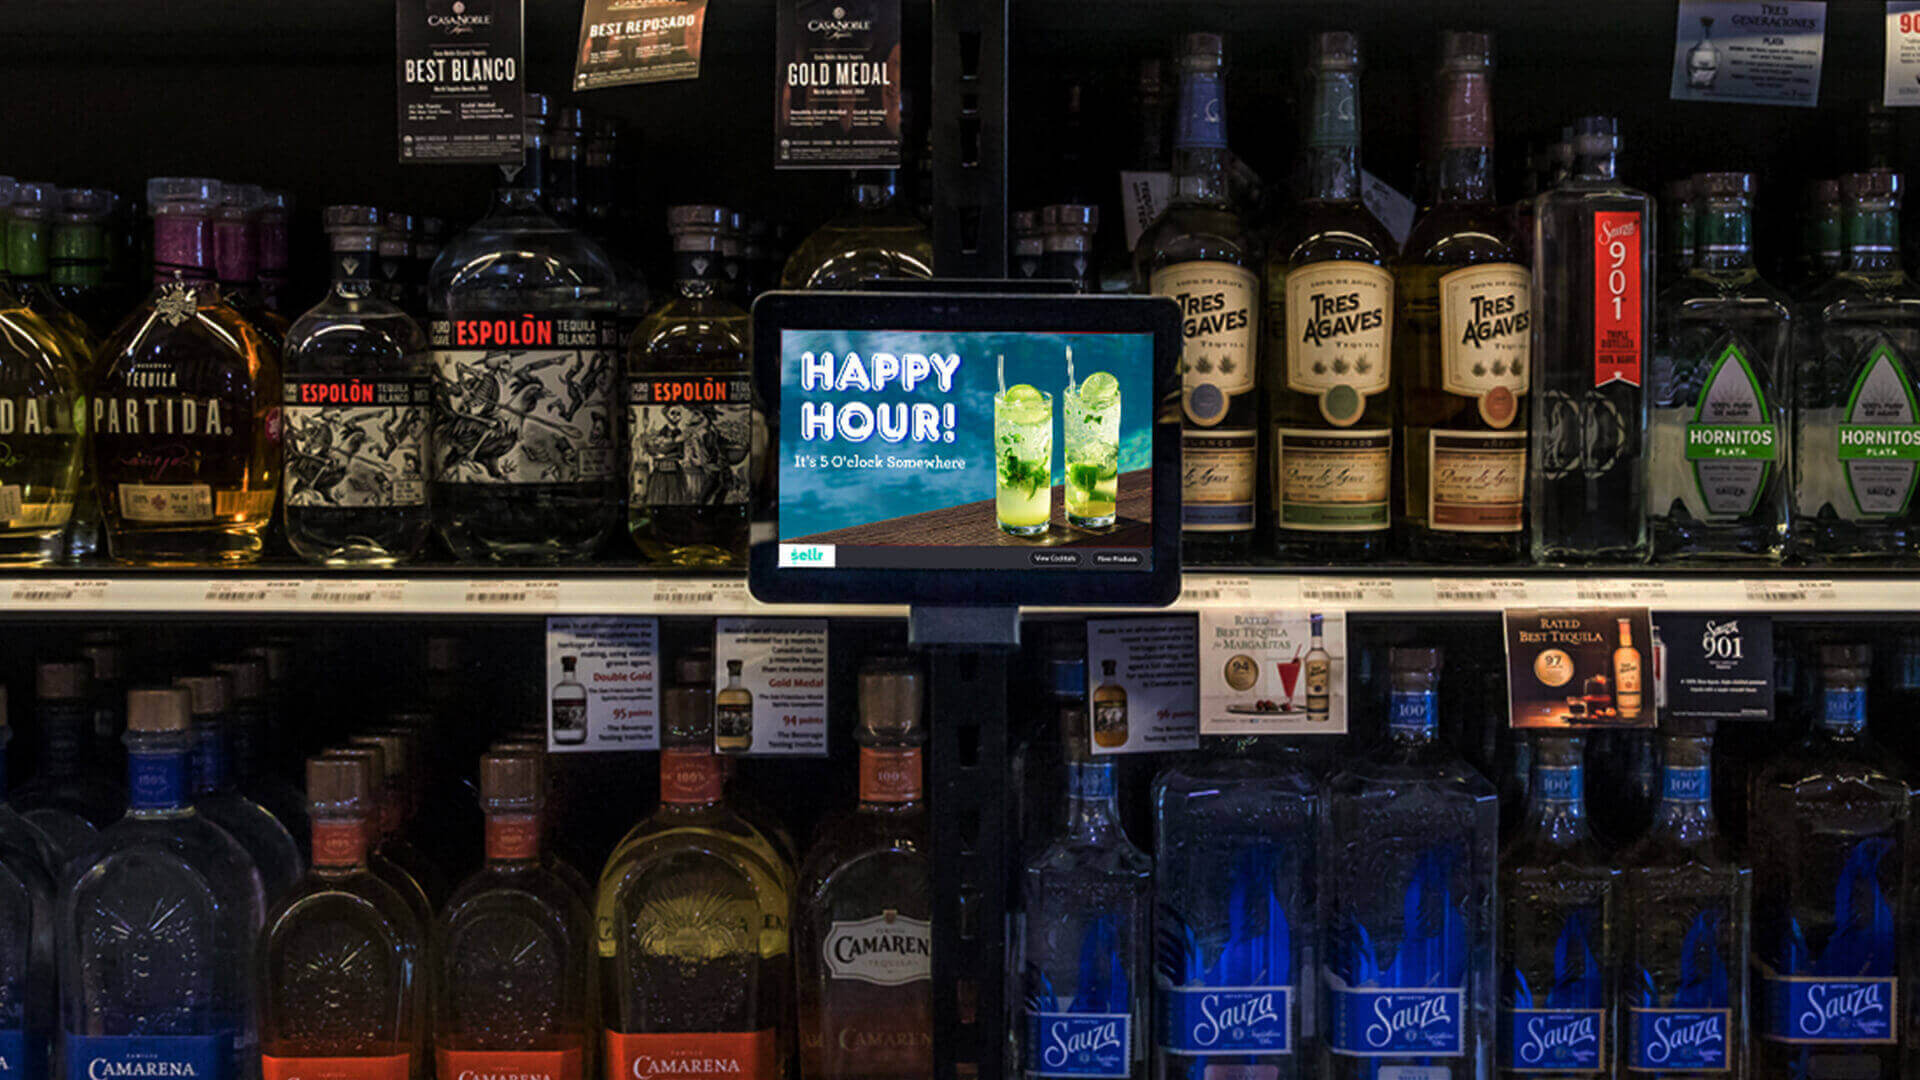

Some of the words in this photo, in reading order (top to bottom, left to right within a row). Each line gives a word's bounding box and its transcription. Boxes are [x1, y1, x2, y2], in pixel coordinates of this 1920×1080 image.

[1731, 13, 1816, 30] GENERACIONES
[1761, 4, 1789, 16] TRES
[590, 22, 622, 38] BEST
[626, 14, 695, 34] REPOSADO
[406, 59, 445, 82] BEST
[452, 57, 515, 82] BLANCO
[788, 62, 830, 86] GOLD
[836, 62, 890, 86] MEDAL
[1608, 241, 1626, 321] 901
[1176, 292, 1225, 316] TRES
[1310, 292, 1360, 325] TRES
[1470, 294, 1515, 326] TRES
[557, 319, 597, 332] TEQUILA
[1183, 308, 1248, 339] GAVES
[1302, 307, 1383, 347] AGAVES
[1461, 309, 1530, 349] AGAVES
[557, 333, 597, 346] BLANCO
[126, 371, 177, 388] TEQUILA
[801, 351, 961, 393] HAPPY
[801, 401, 956, 444] HOUR!
[1690, 429, 1773, 446] HORNITOS
[1841, 429, 1920, 446] HORNITOS
[794, 454, 817, 469] It's
[820, 454, 829, 469] 5
[831, 453, 883, 469] O'clock
[886, 455, 967, 470] Somewhere
[1715, 447, 1748, 456] PLATA
[1866, 447, 1898, 456] PLATA
[1234, 615, 1270, 626] RATED
[1541, 618, 1580, 629] RATED
[1216, 627, 1241, 638] BEST
[1243, 627, 1288, 640] TEQUILA
[1223, 639, 1291, 650] MARGARITAS
[1519, 630, 1547, 642] BEST
[1549, 630, 1604, 645] TEQUILA
[1702, 636, 1744, 659] 901
[1233, 661, 1249, 673] 94
[1545, 655, 1563, 667] 97
[593, 672, 628, 682] Double
[630, 671, 653, 681] Gold
[768, 678, 793, 688] Gold
[794, 678, 824, 688] Medal
[612, 708, 628, 719] 95
[835, 934, 930, 964] CAMAREN
[1194, 993, 1278, 1046] Sauza
[1800, 983, 1883, 1035] Sauza
[1366, 995, 1451, 1048] Sauza
[1044, 1020, 1121, 1067] Sauza
[1521, 1016, 1596, 1063] Sauza
[1647, 1016, 1722, 1063] Sauza
[88, 1057, 197, 1080] CAMARENA
[633, 1055, 741, 1080] CAMARENA
